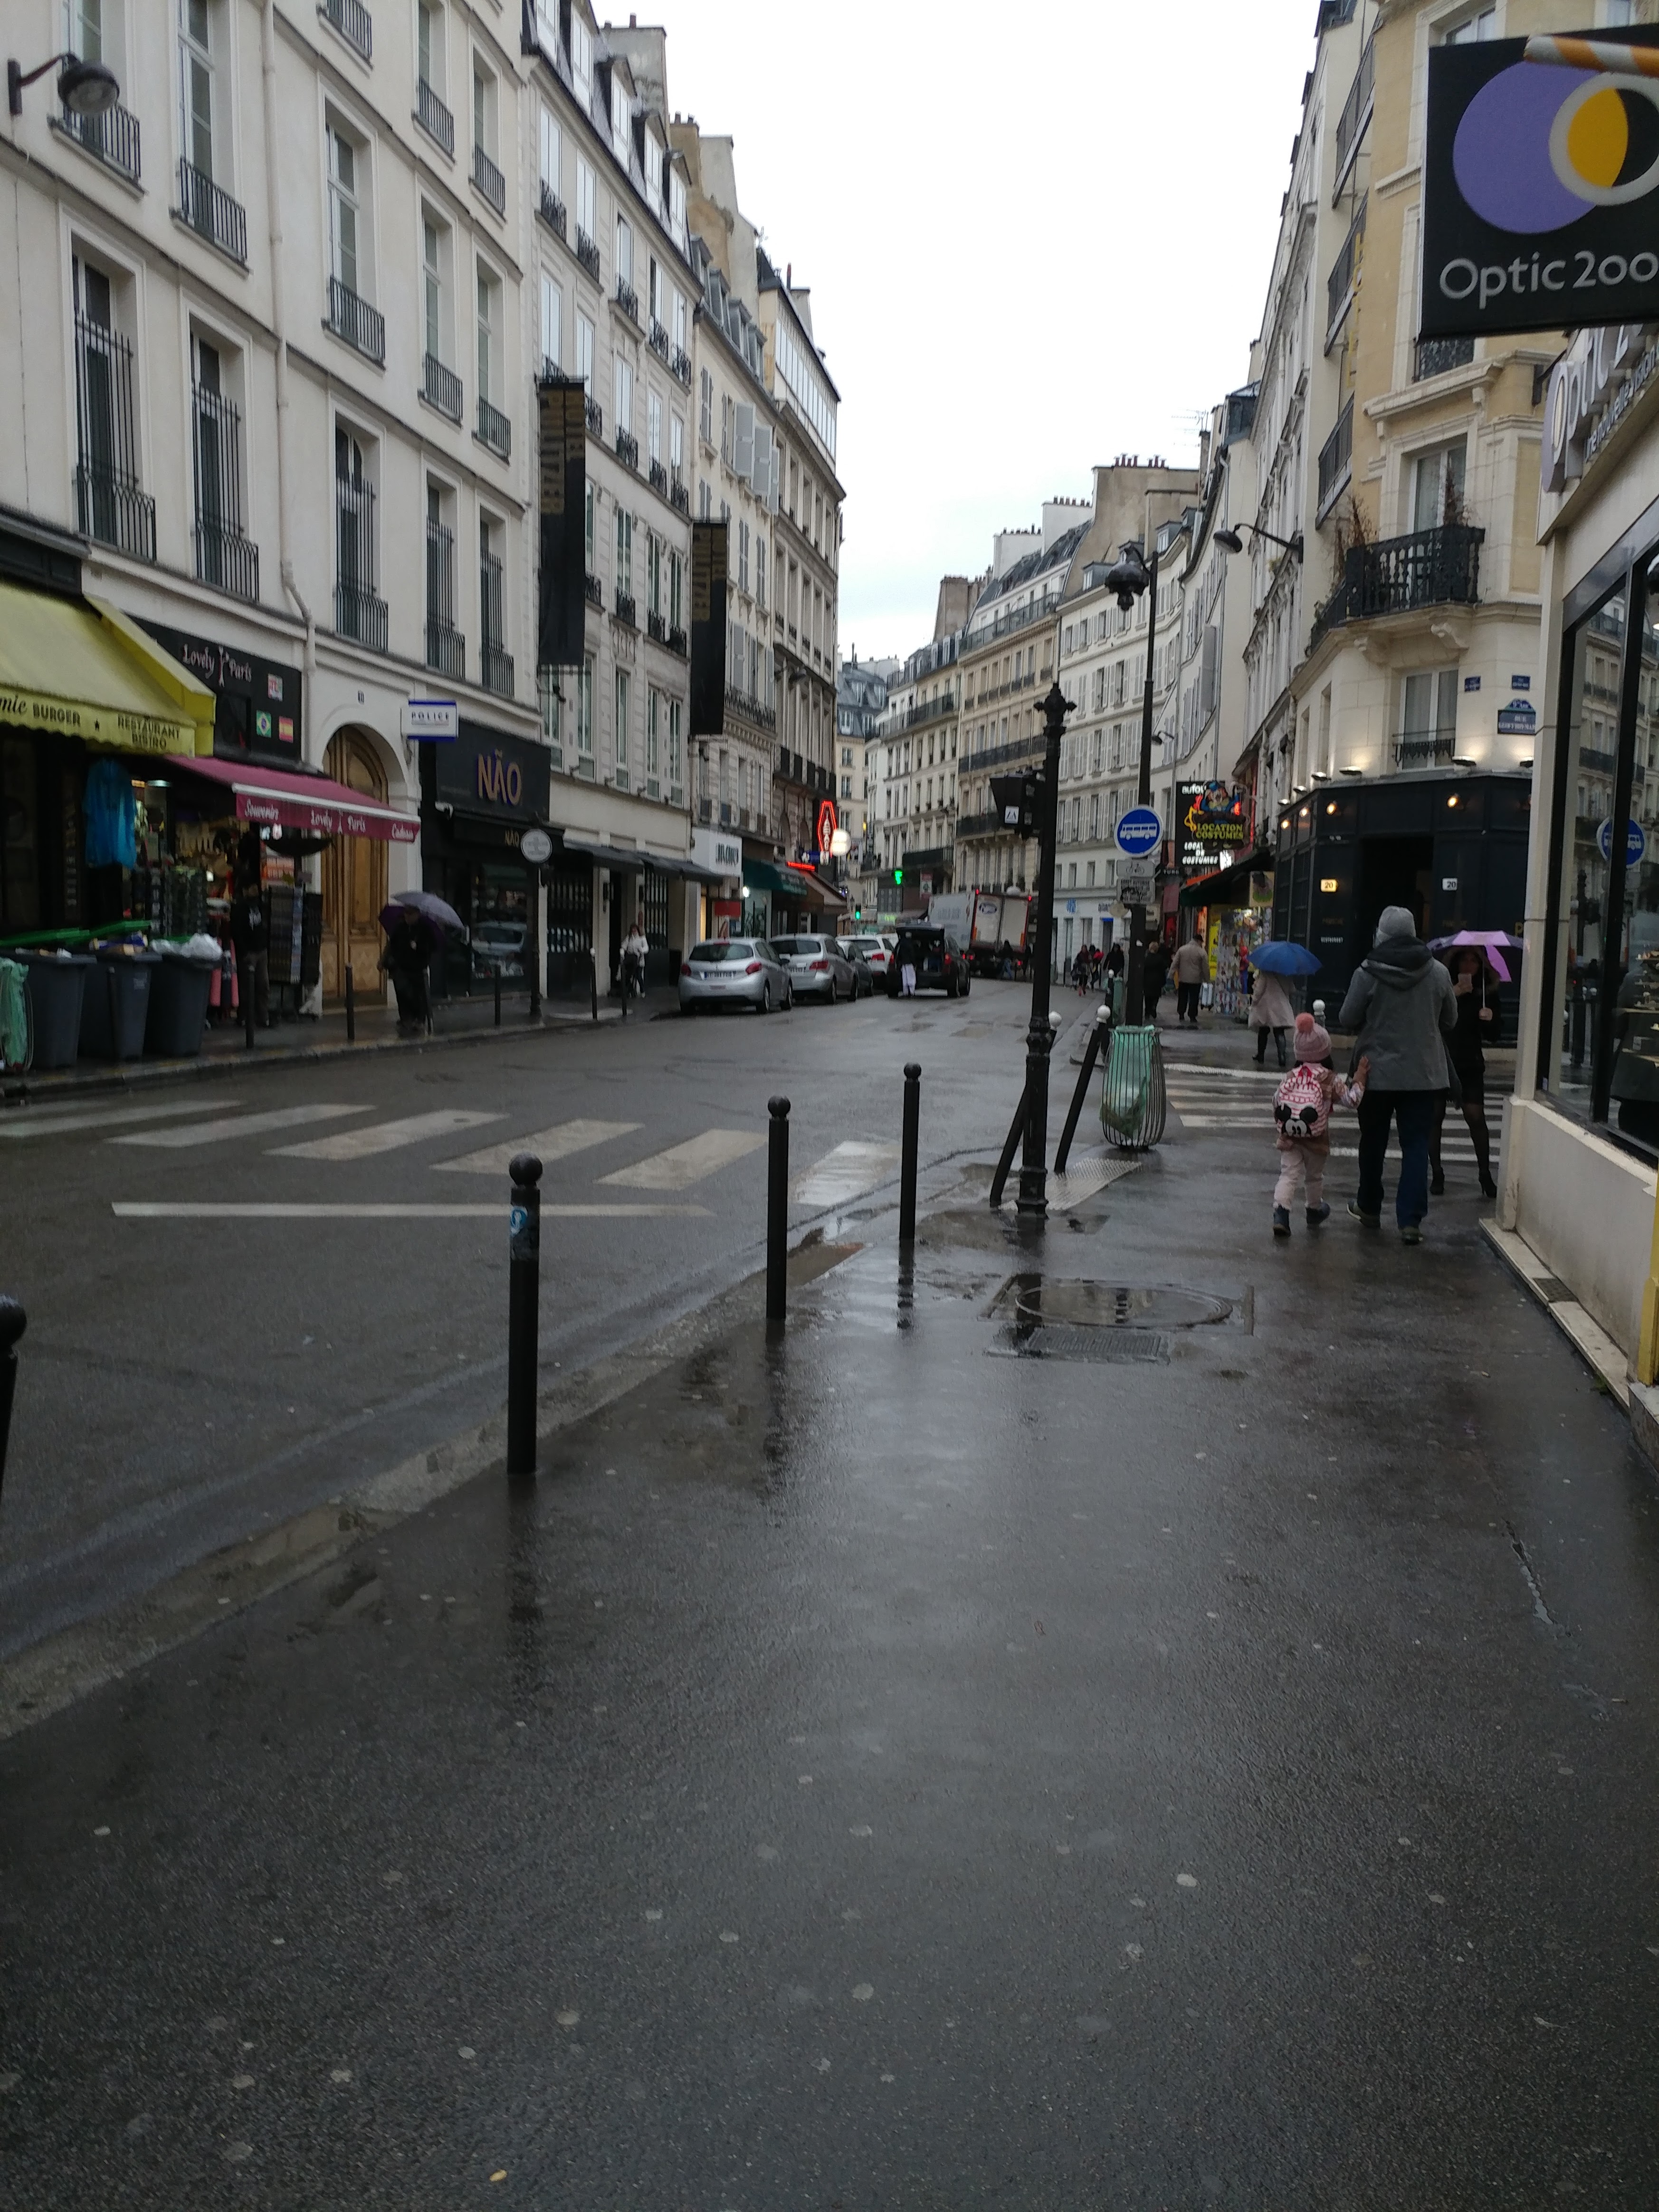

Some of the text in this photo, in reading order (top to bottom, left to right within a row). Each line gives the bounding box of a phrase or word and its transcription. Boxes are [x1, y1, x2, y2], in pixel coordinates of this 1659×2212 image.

[1439, 250, 1659, 309] Optic 200
[182, 643, 252, 683] Lovely Paris
[33, 701, 81, 727] BURGER
[411, 712, 449, 721] POLICE
[117, 713, 181, 741] RESTAURANT
[132, 732, 167, 751] BISTRO
[478, 748, 522, 806] NÃO
[245, 799, 279, 821] Souvenirs
[311, 809, 333, 832] Lovely
[348, 815, 366, 833] Paris
[1196, 831, 1244, 840] COSTUMES
[1198, 823, 1242, 832] LOCATION
[1184, 841, 1203, 850] LOCAT
[1182, 856, 1218, 865] COSTUMES
[1447, 881, 1456, 889] 20
